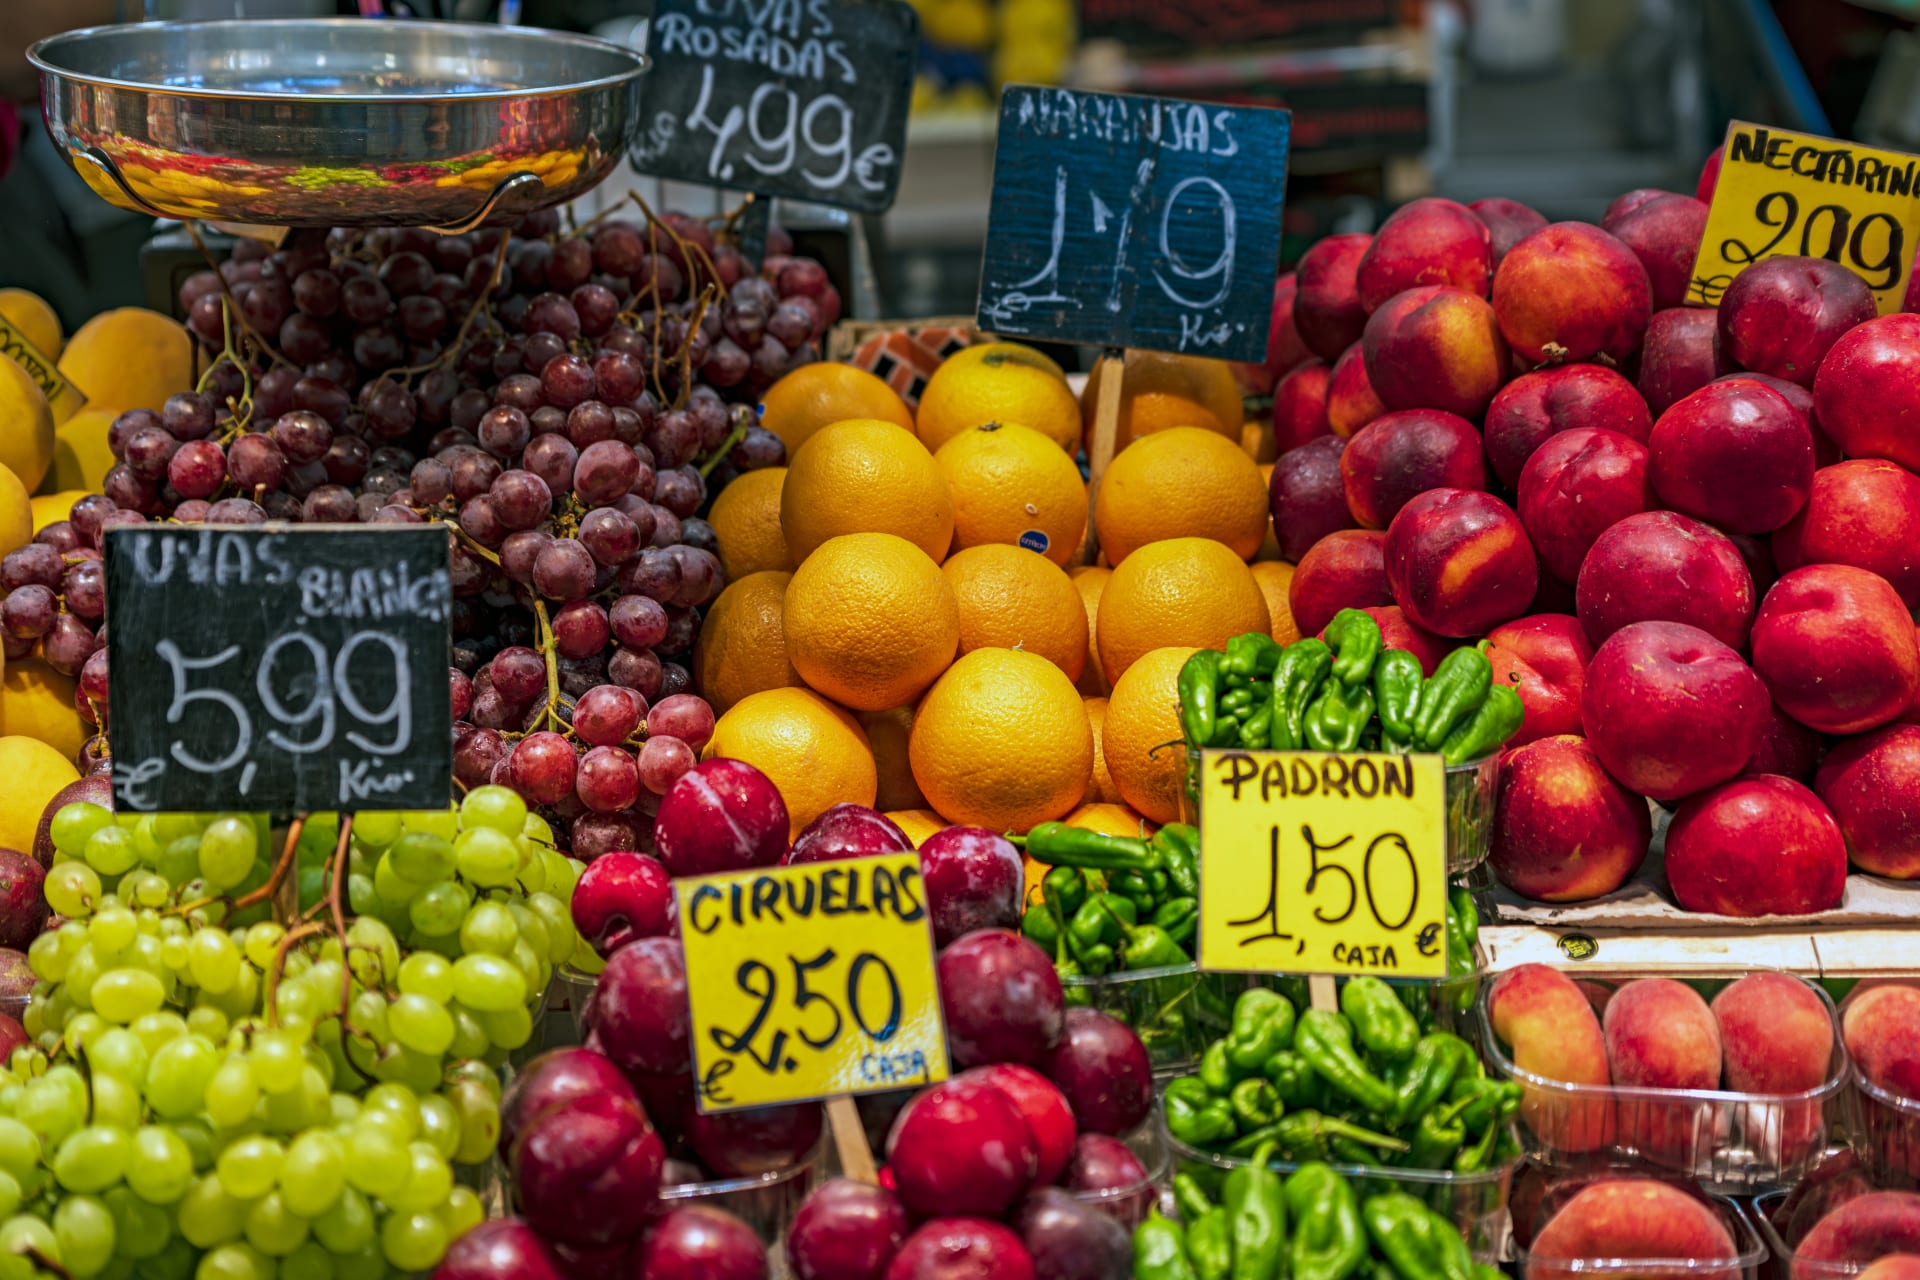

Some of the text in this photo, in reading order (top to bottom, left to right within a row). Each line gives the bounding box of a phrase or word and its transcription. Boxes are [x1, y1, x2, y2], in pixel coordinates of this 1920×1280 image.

[656, 14, 857, 83] ROSADAS
[132, 532, 291, 584] UVAS
[1215, 753, 1414, 803] PADRON
[690, 864, 926, 936] CIRUELAS
[1332, 942, 1398, 968] CAJA
[860, 1049, 931, 1084] CAJA
